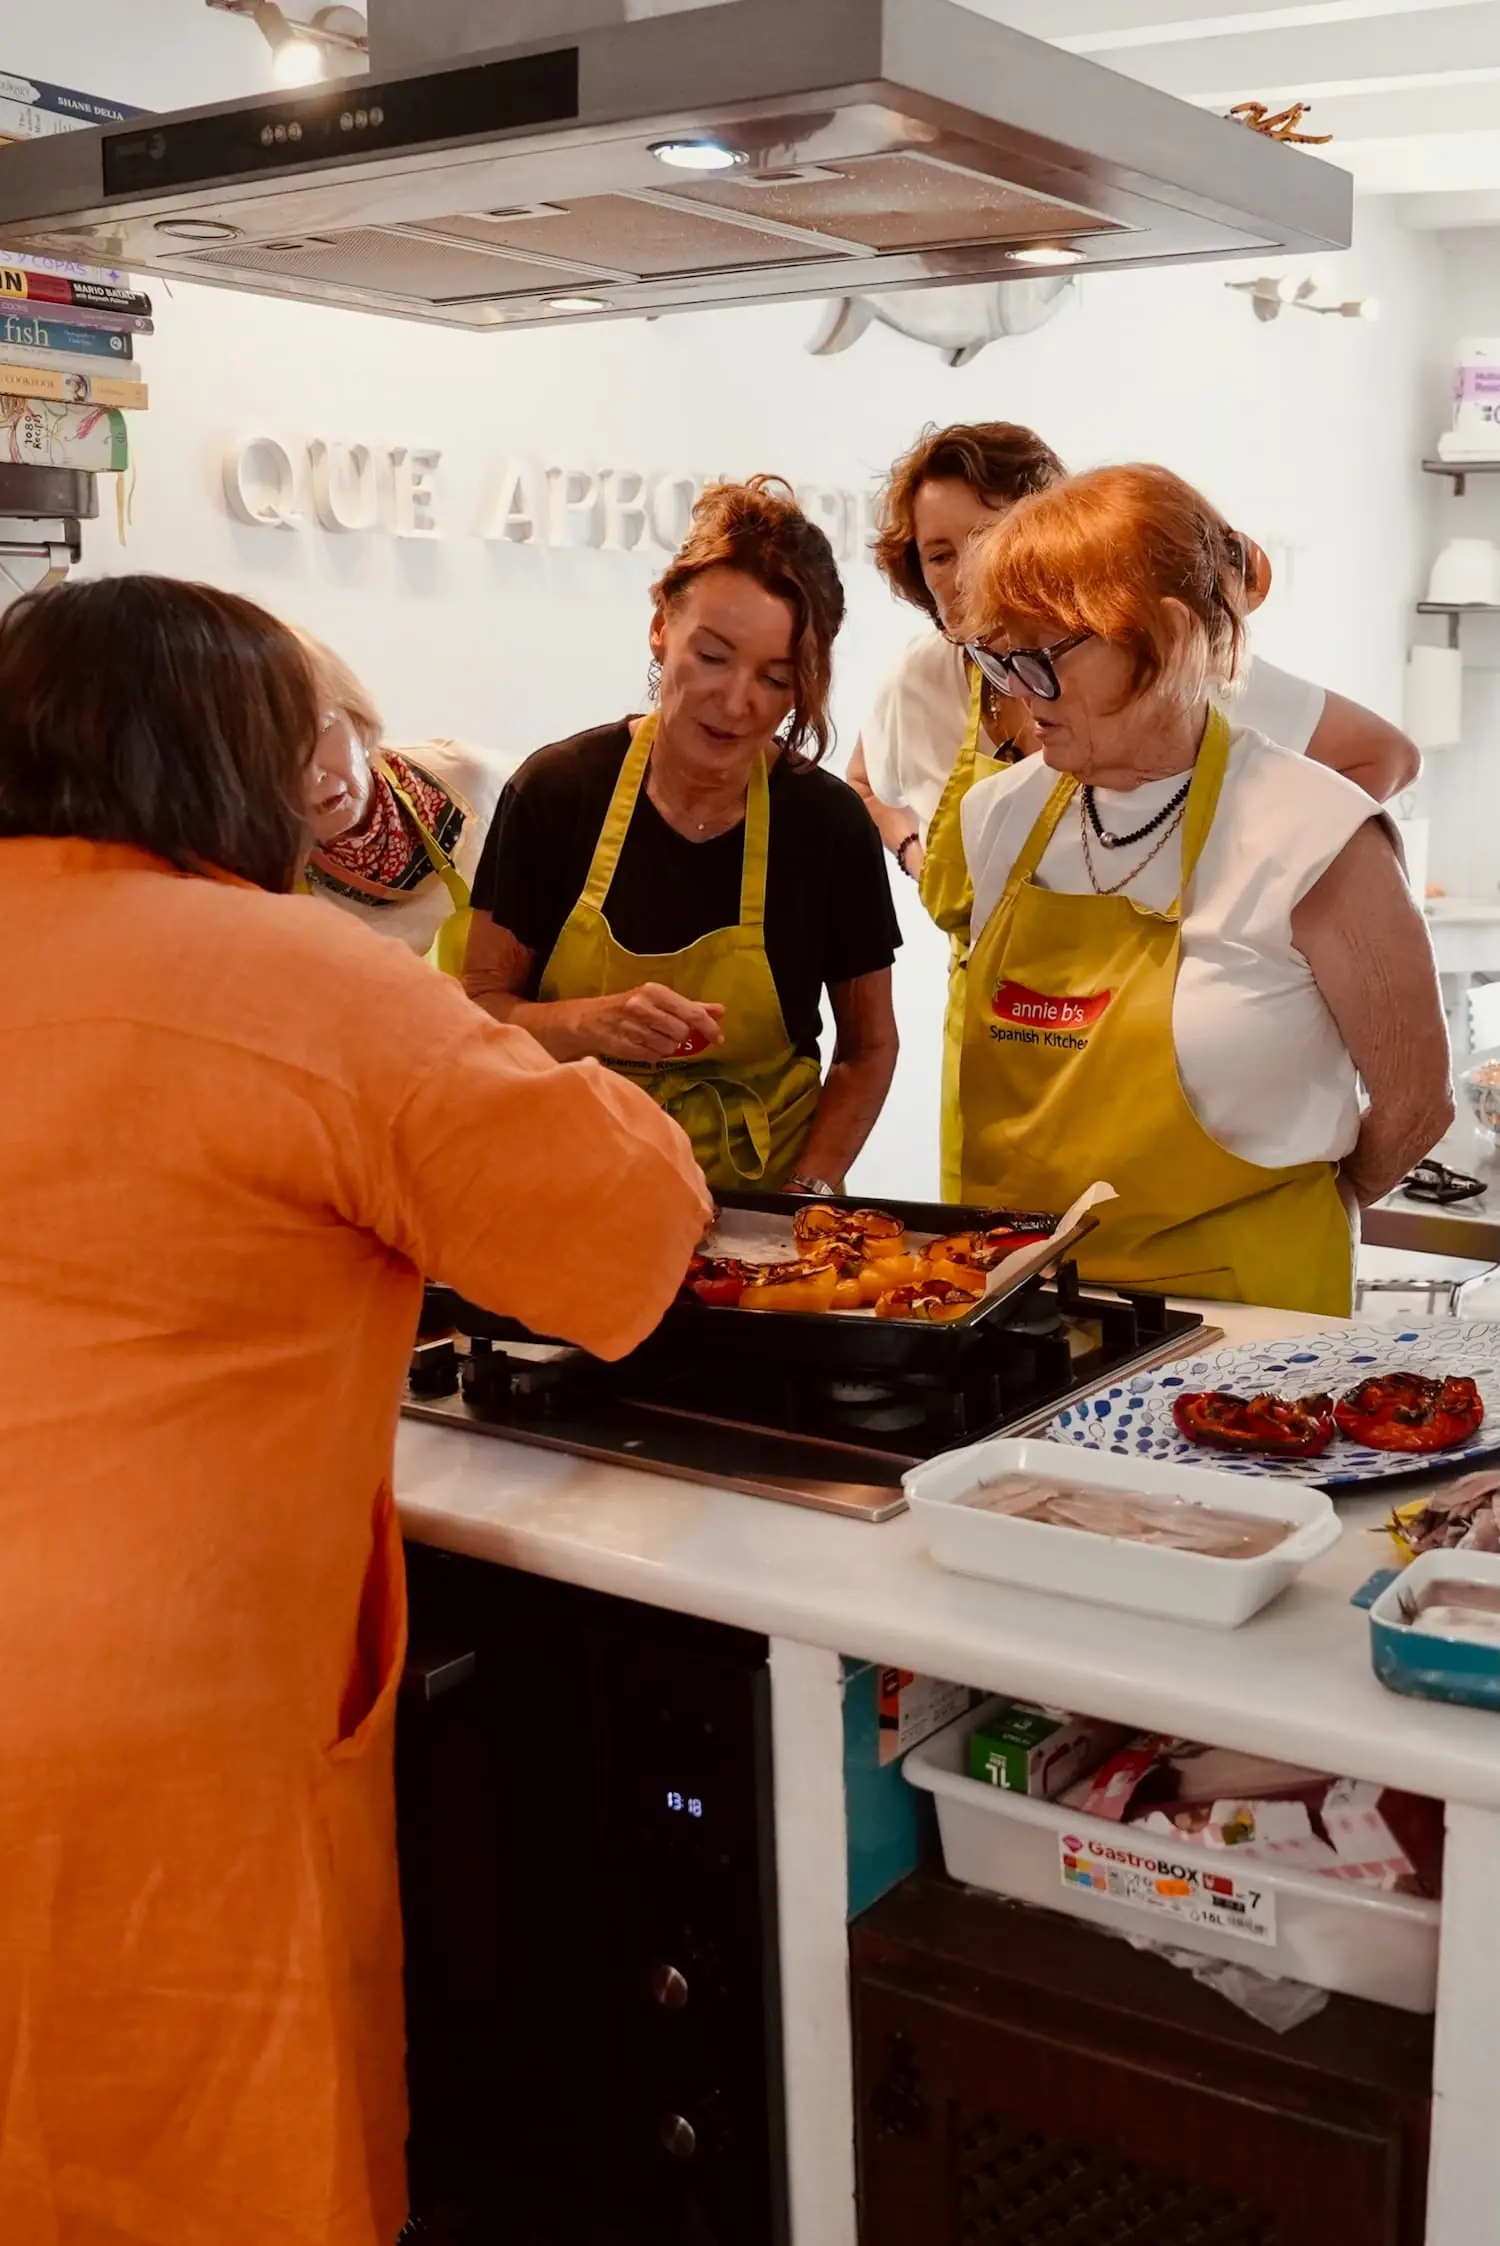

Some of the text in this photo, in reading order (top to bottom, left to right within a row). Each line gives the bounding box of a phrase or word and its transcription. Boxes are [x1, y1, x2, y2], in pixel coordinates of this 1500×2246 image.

[57, 96, 125, 121] SHANE DELIA
[32, 256, 88, 276] COPAS
[73, 283, 105, 296] MARIO
[4, 316, 51, 348] fish
[222, 437, 442, 540] QUE
[1012, 1002, 1085, 1022] annie b's
[990, 1025, 1039, 1045] Spanish
[1088, 1841, 1200, 1885] GastroBOX
[1249, 1890, 1261, 1909] 7
